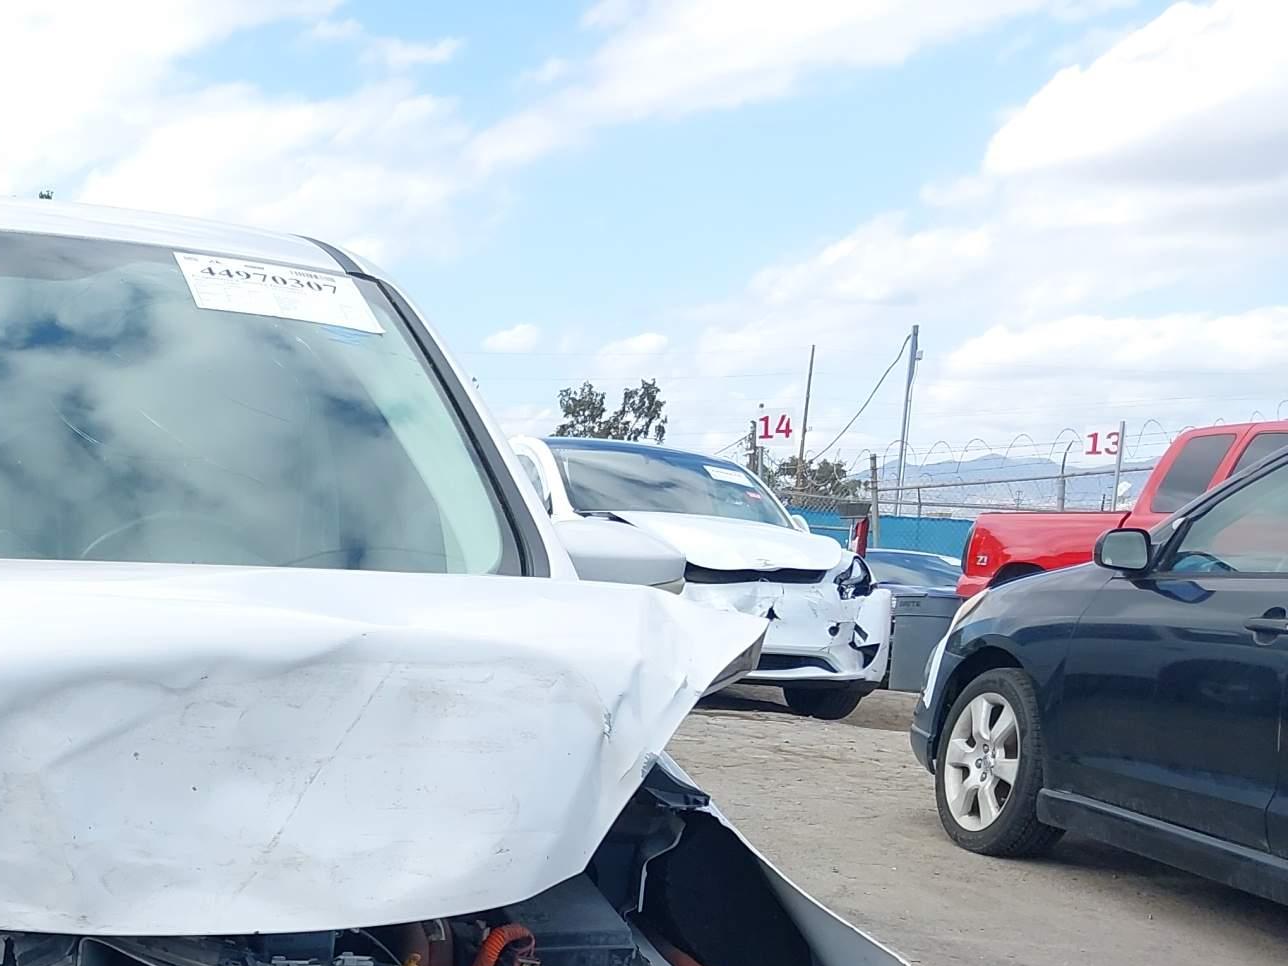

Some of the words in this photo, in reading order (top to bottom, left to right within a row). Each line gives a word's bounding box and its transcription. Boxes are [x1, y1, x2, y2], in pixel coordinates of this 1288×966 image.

[199, 265, 337, 295] 44970307
[758, 414, 793, 440] 14
[1085, 431, 1120, 456] 13
